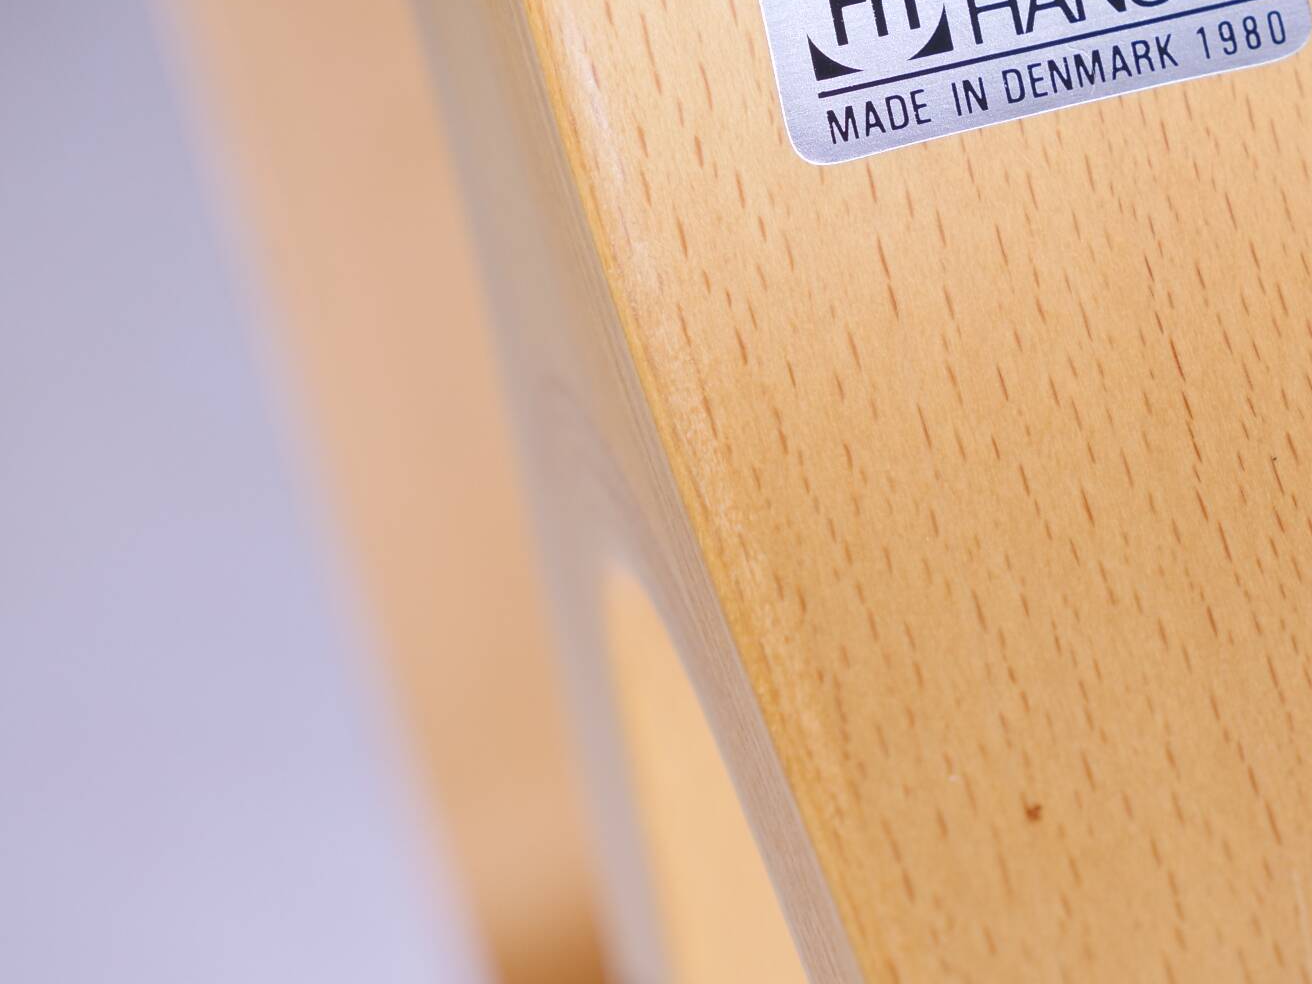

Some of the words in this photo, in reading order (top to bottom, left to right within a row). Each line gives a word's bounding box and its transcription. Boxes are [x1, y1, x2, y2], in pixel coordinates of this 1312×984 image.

[826, 88, 932, 145] MADE
[951, 76, 989, 117] IN
[1001, 33, 1179, 104] DENMARK
[1196, 10, 1287, 60] 1980
